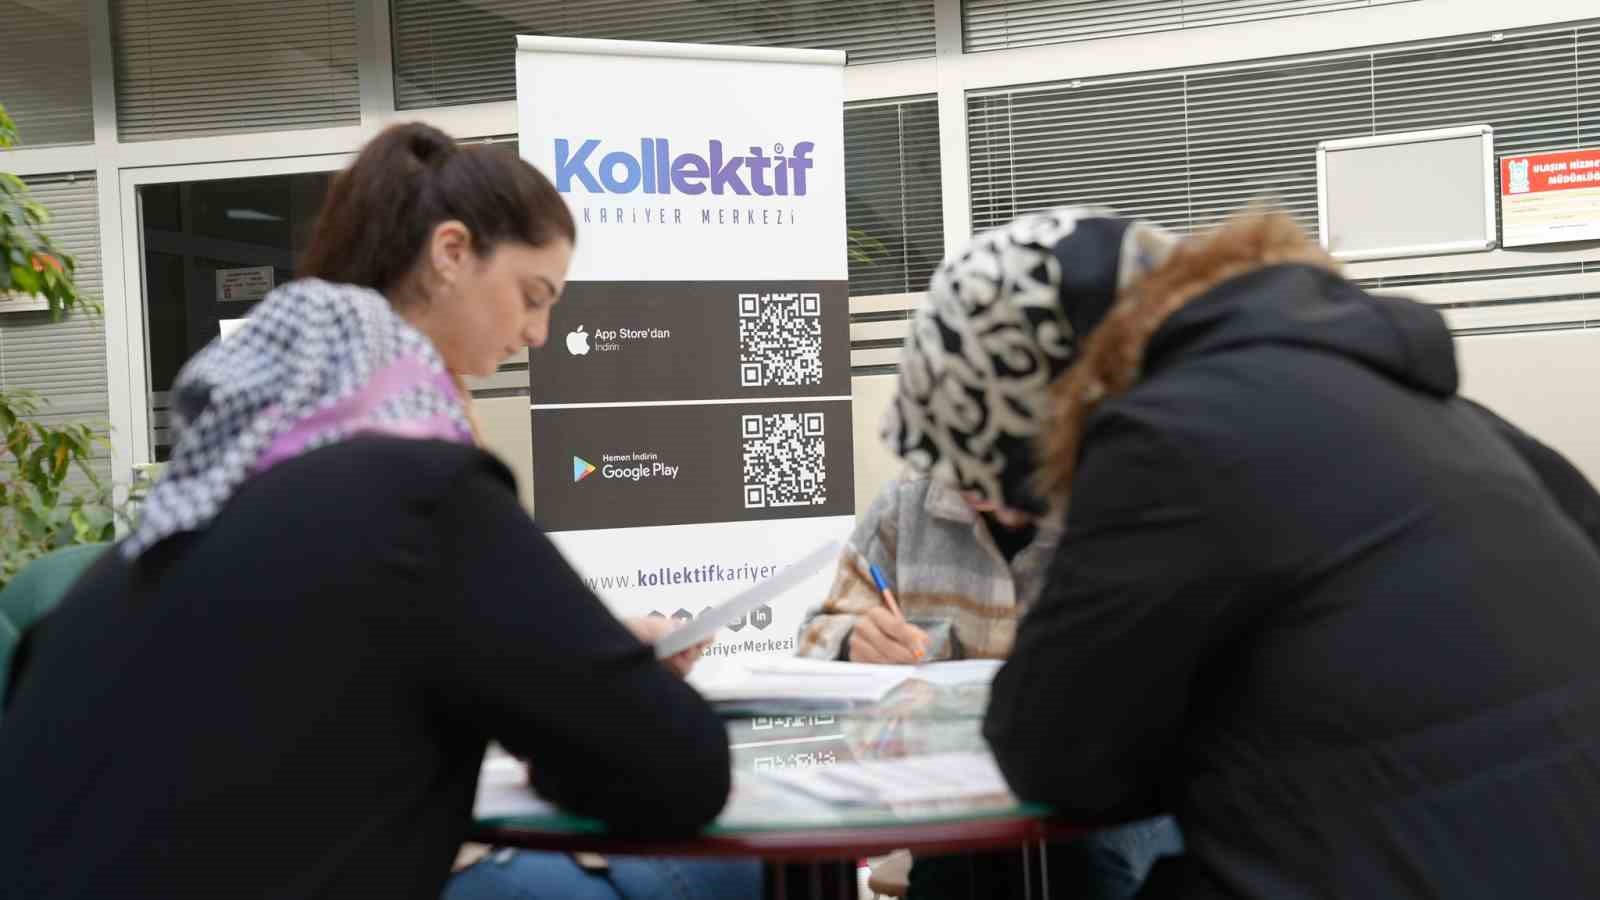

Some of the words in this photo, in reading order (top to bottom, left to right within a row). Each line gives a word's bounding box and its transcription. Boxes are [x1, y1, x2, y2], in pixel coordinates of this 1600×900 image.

[554, 137, 815, 196] Kollektif
[595, 328, 617, 340] App
[619, 328, 670, 338] Store'dan
[602, 454, 631, 462] Hemen
[602, 464, 650, 481] Google
[652, 462, 679, 480] Play
[584, 563, 793, 591] www.kollektifkariyer
[702, 637, 794, 657] ariyerMerkezi
